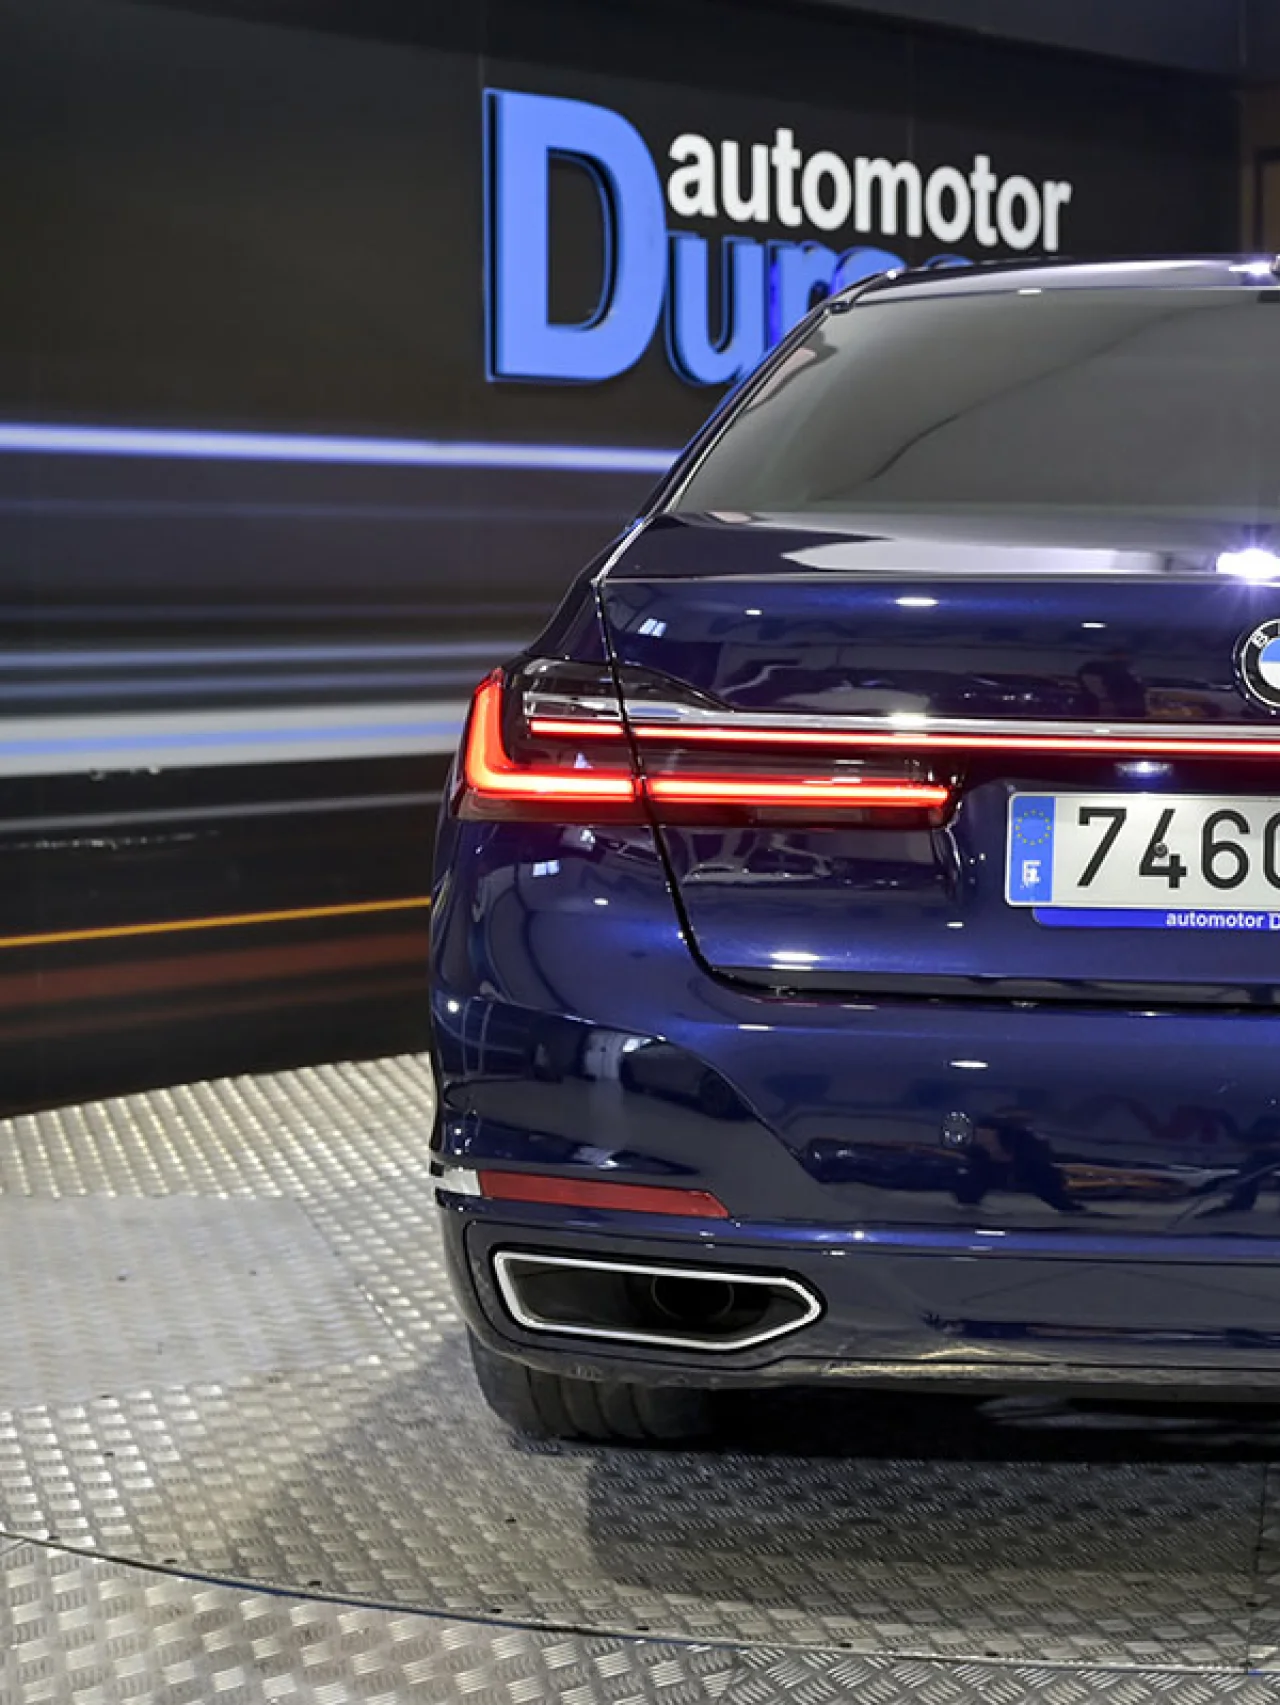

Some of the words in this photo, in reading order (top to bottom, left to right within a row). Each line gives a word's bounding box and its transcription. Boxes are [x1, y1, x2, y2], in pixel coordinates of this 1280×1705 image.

[483, 87, 972, 386] Dur
[667, 127, 1072, 251] automotor
[1166, 911, 1264, 928] automotor
